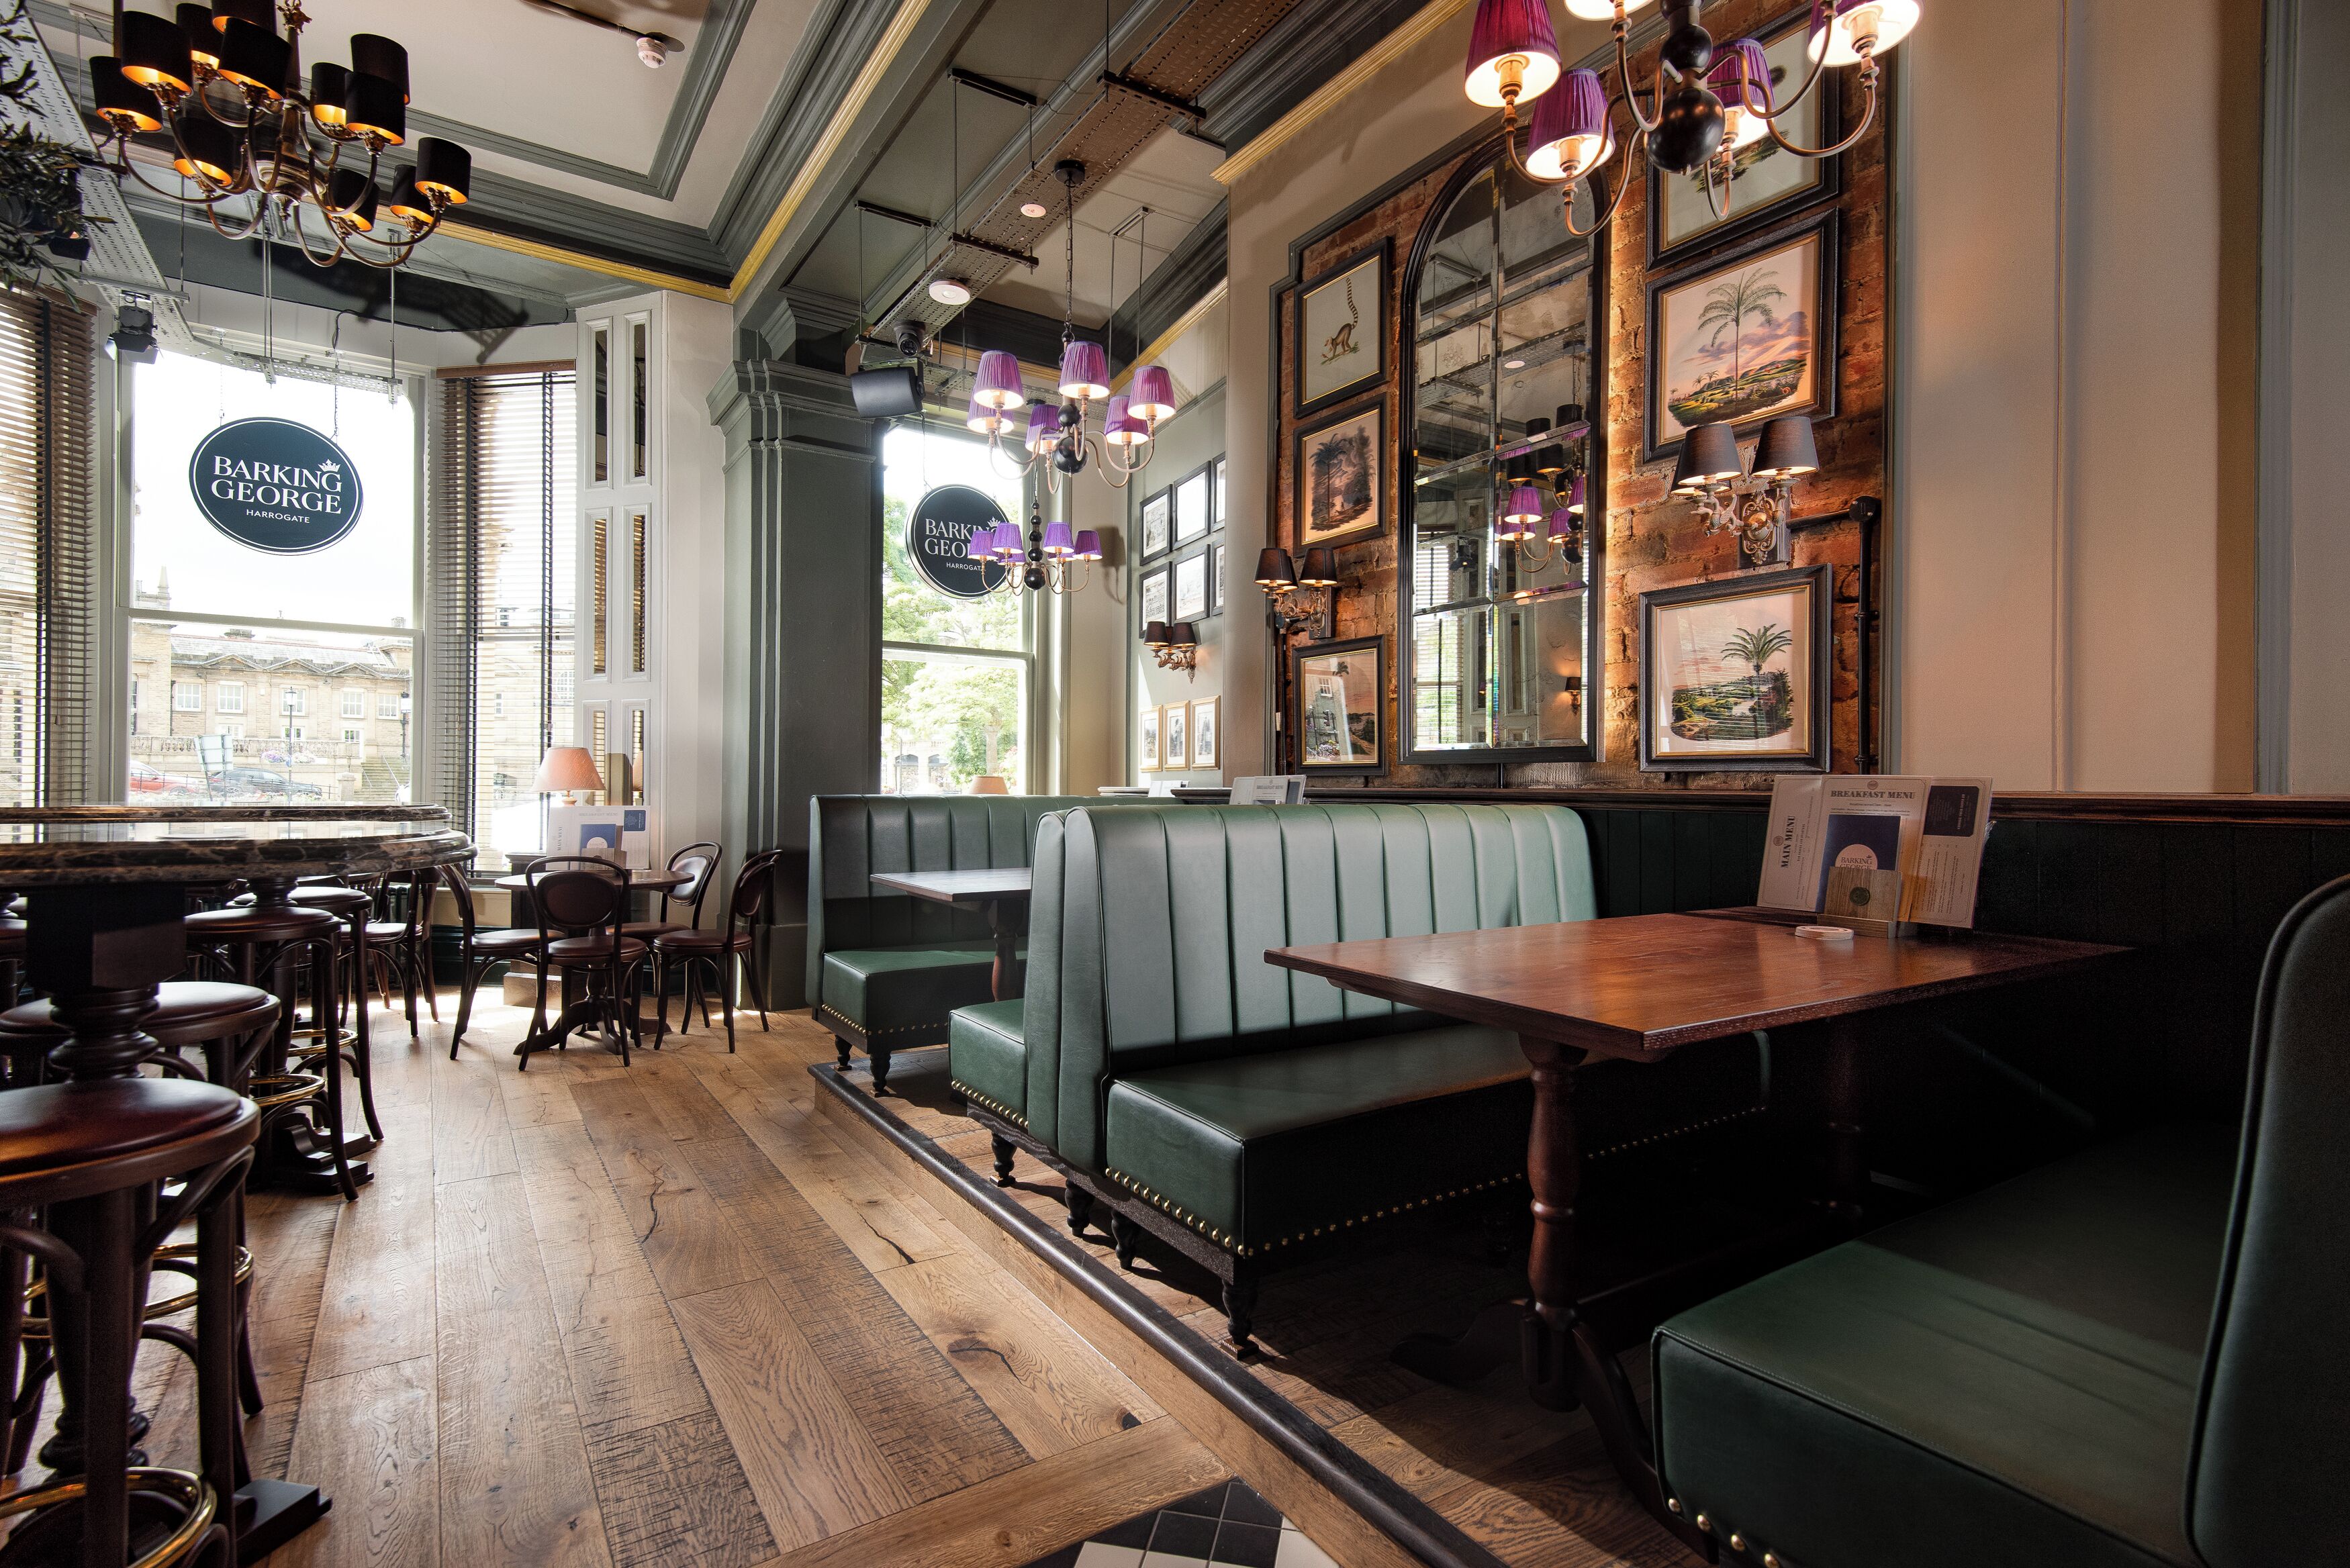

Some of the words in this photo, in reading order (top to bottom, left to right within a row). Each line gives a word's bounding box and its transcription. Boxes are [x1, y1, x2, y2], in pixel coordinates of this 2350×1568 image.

[214, 456, 342, 493] BARKING
[211, 479, 342, 514] GEORGE
[246, 509, 310, 524] HARROGATE
[925, 518, 996, 540] BARK
[946, 562, 982, 572] HARROGAT
[1830, 790, 1885, 799] BREAKFAST
[1887, 791, 1915, 799] MENU
[1785, 816, 1795, 842] MENU
[1781, 844, 1791, 868] MAIN
[1841, 856, 1872, 865] BARKING
